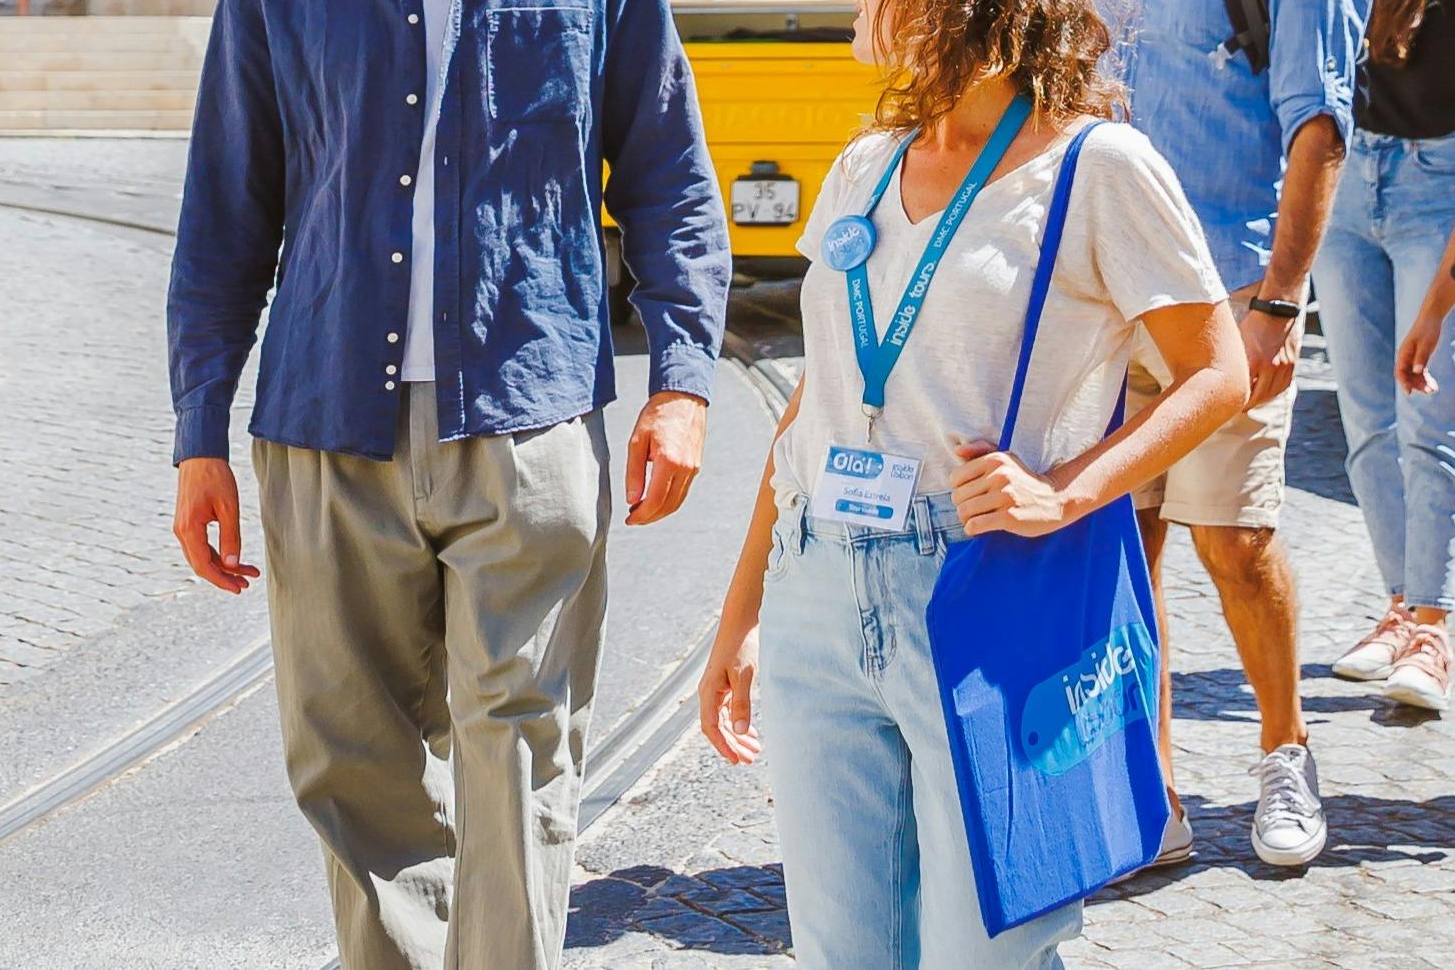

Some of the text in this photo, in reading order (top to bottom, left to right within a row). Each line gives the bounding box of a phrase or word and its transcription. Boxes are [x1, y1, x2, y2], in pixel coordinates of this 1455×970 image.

[733, 203, 759, 218] PV
[753, 182, 777, 199] 35
[933, 182, 978, 248] DMC PORTUGAL
[851, 278, 870, 349] DMC PORTUGAL
[886, 305, 916, 346] inside
[833, 452, 873, 475] Olá!
[1063, 642, 1135, 714] inside
